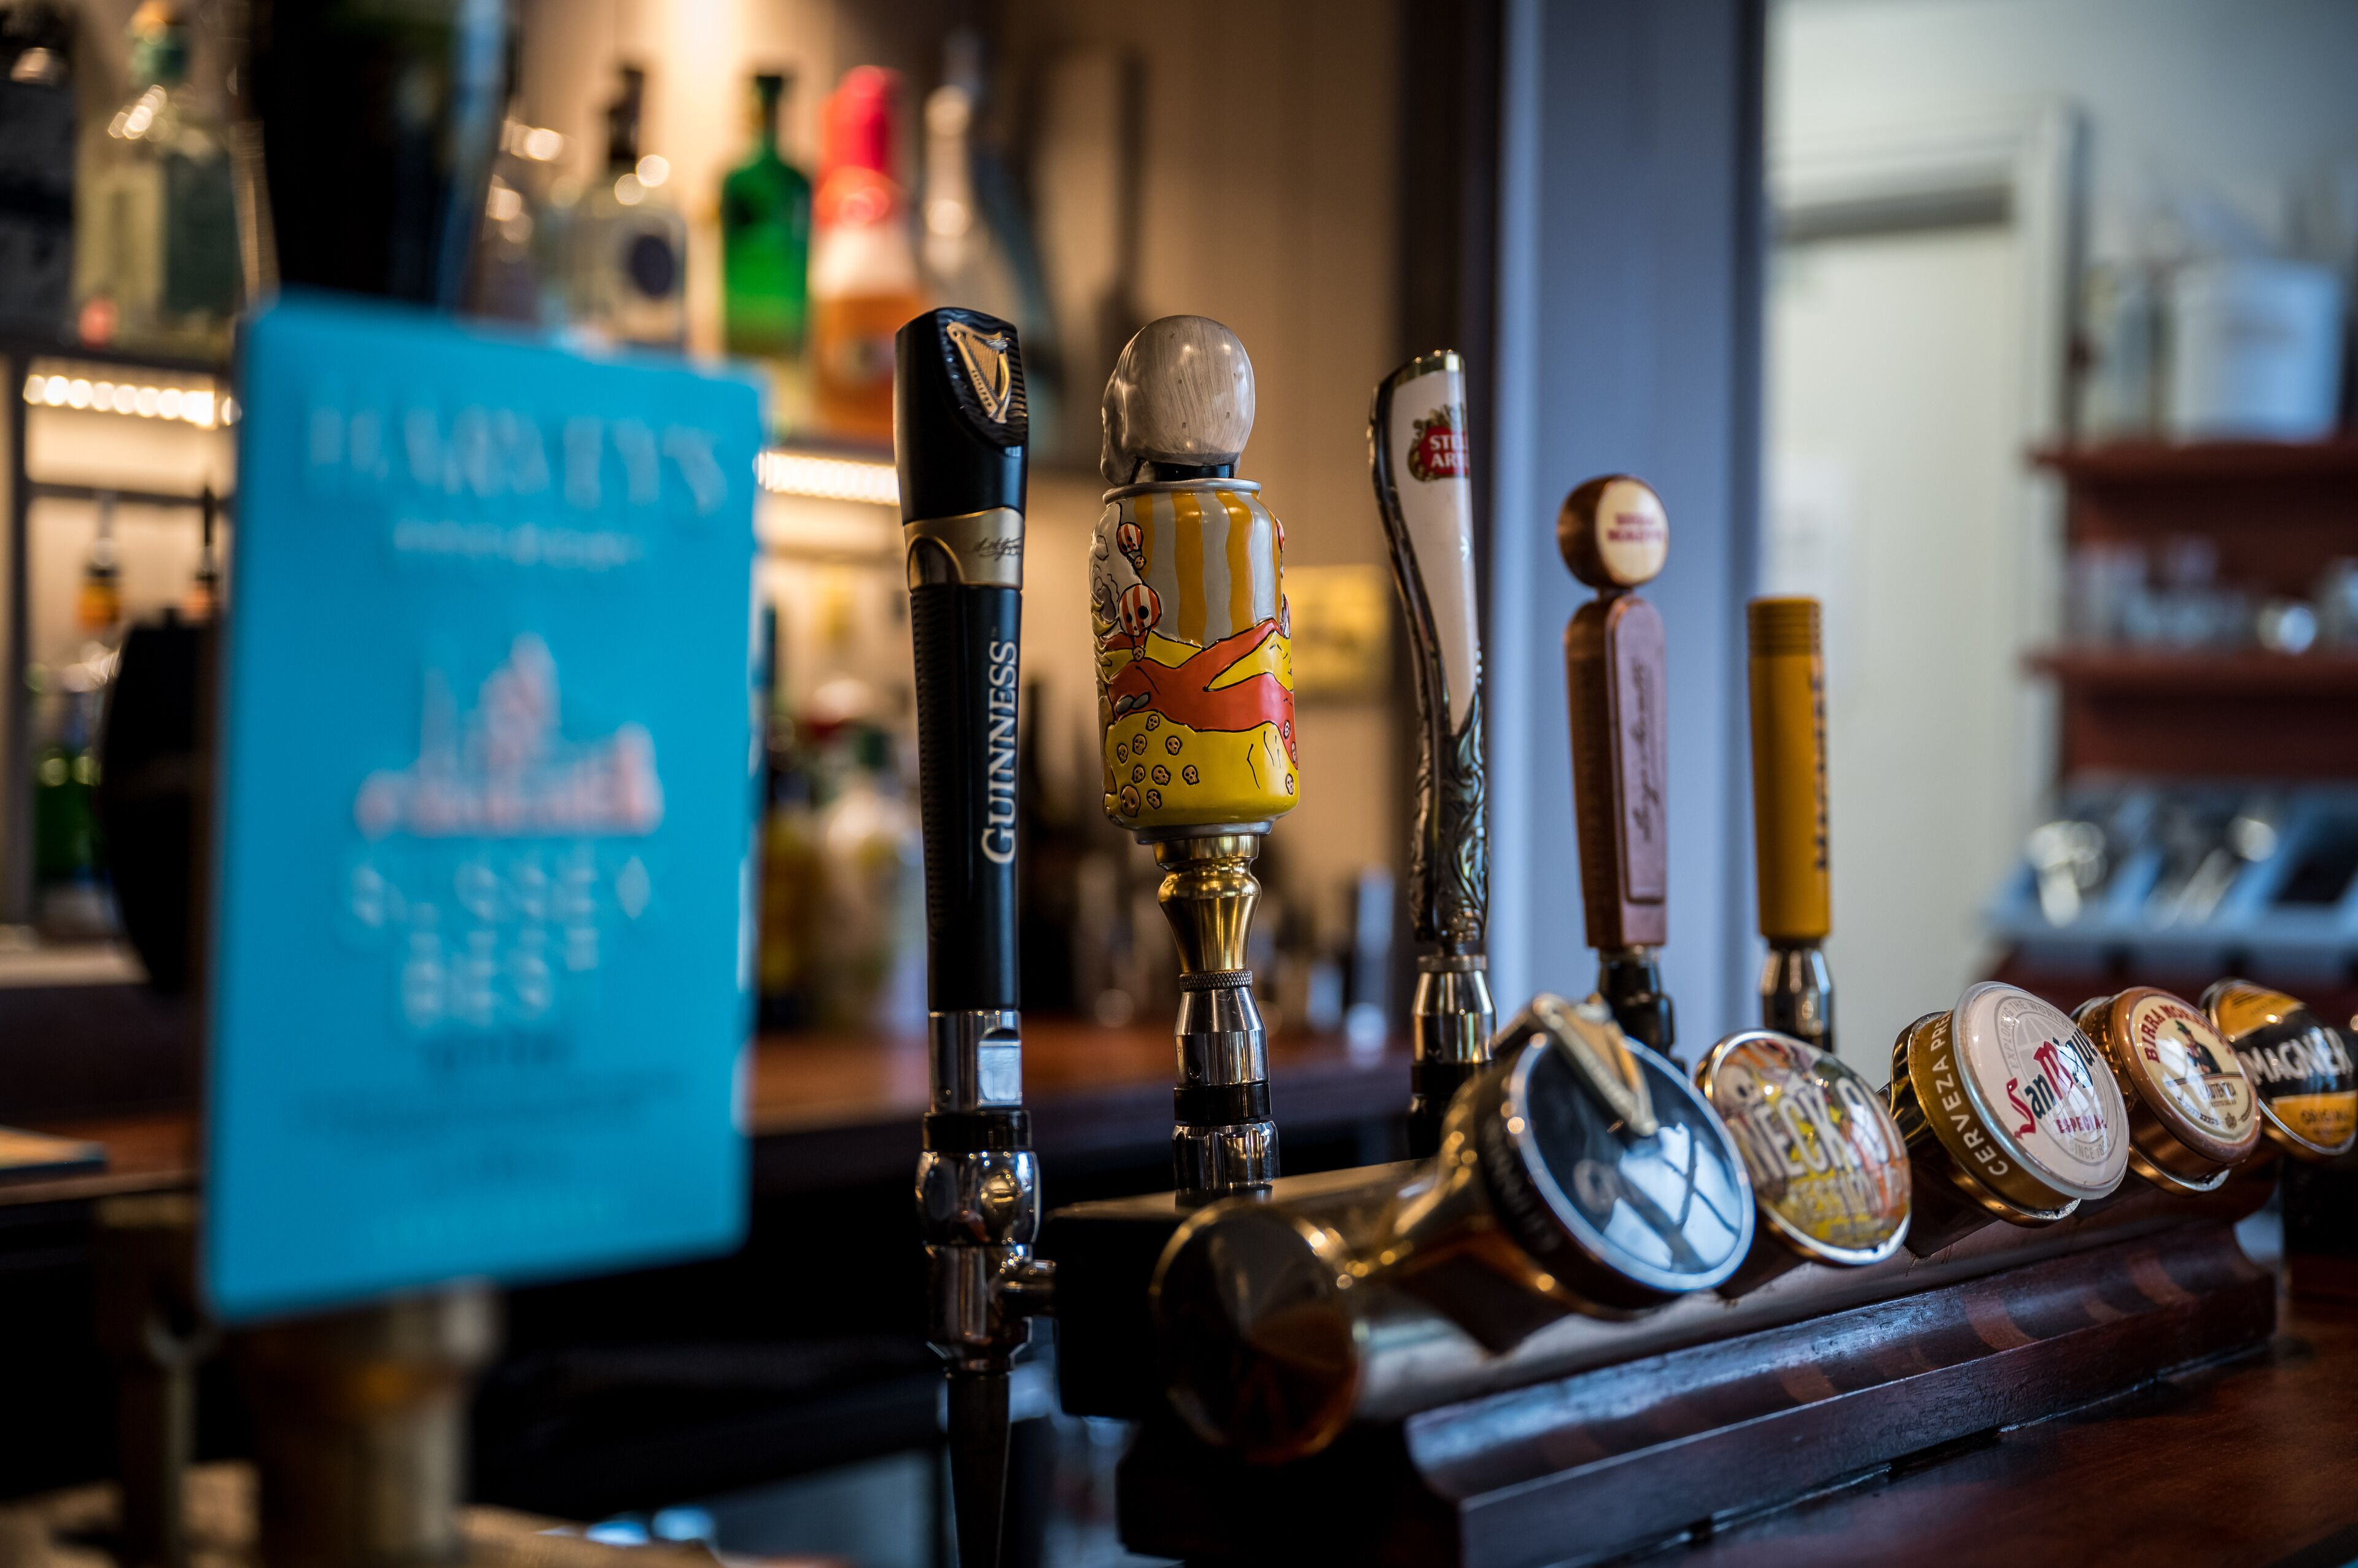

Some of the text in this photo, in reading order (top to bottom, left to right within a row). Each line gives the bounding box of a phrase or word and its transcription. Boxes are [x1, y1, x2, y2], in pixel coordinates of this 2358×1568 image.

[981, 640, 1018, 866] GUINNESS
[2001, 999, 2068, 1069] EXPLORG THE WORLD
[2141, 1009, 2166, 1063] BIRRA
[1930, 1010, 2009, 1176] CERVEZA PRE
[2006, 1073, 2057, 1141] San
[1727, 1084, 1862, 1185] NECK
[2069, 1136, 2111, 1160] SINCE 180
